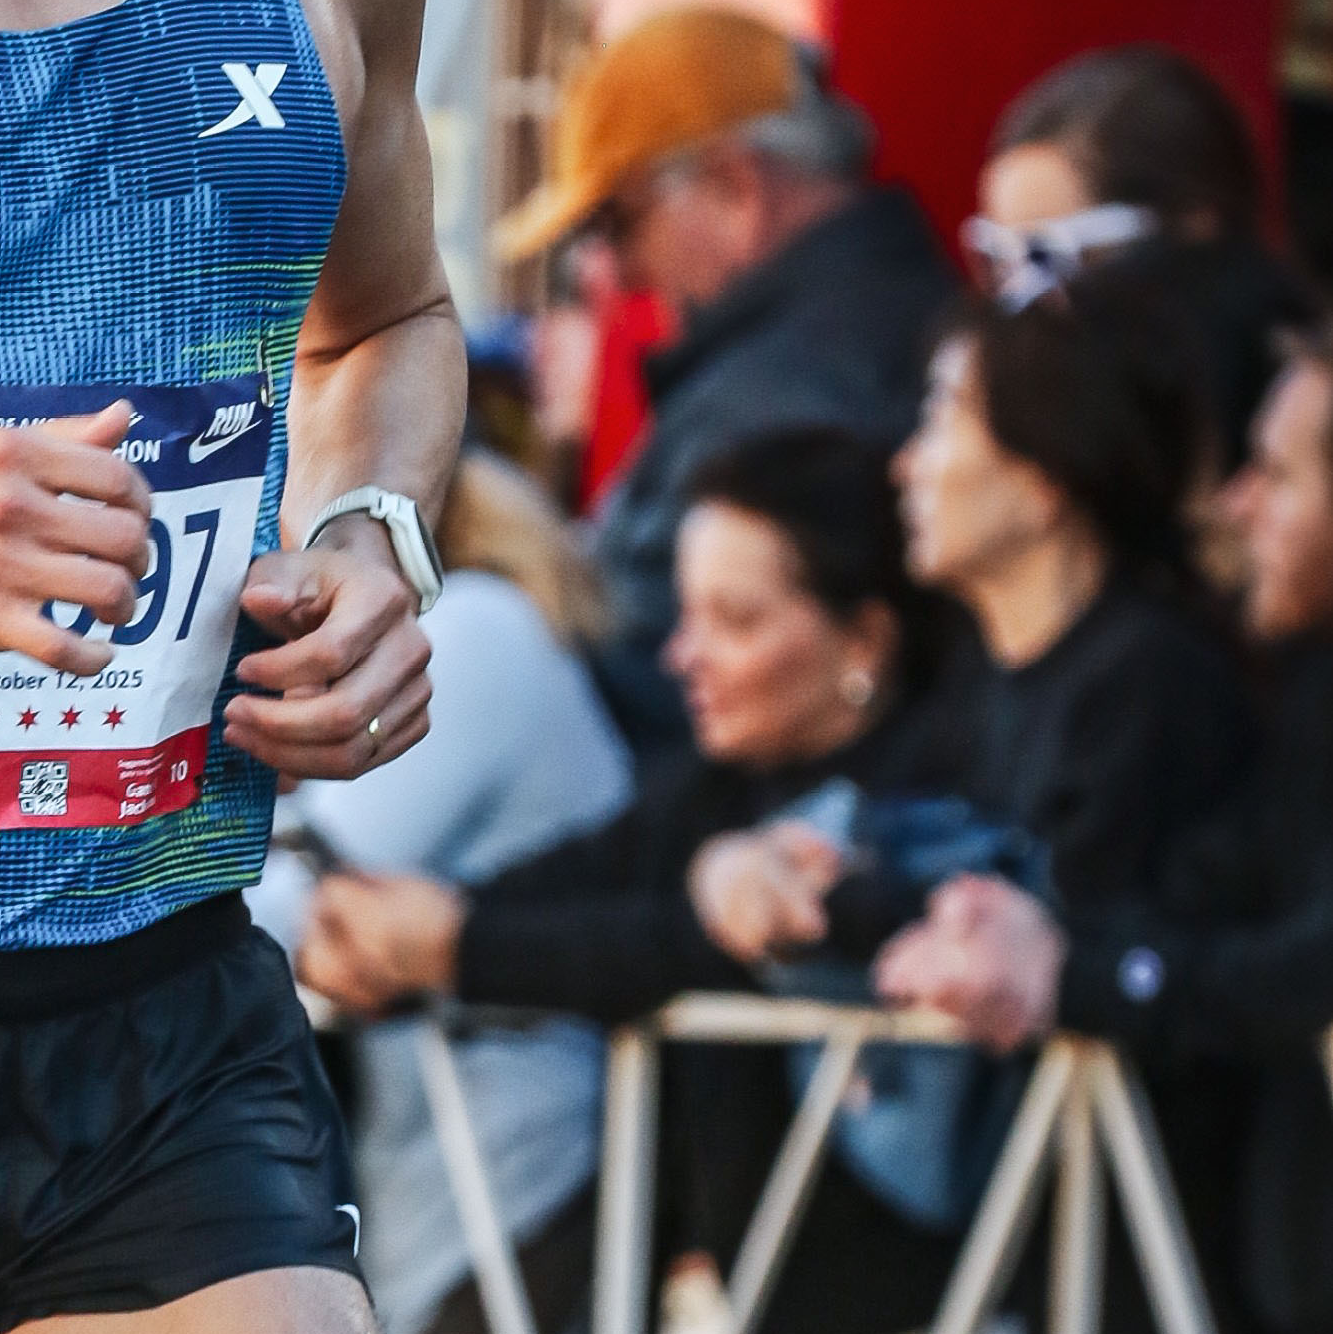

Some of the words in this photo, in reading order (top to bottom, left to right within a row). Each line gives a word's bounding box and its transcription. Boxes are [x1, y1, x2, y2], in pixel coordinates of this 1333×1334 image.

[204, 401, 256, 438] RUN
[91, 669, 143, 689] 2025
[171, 759, 188, 783] 10
